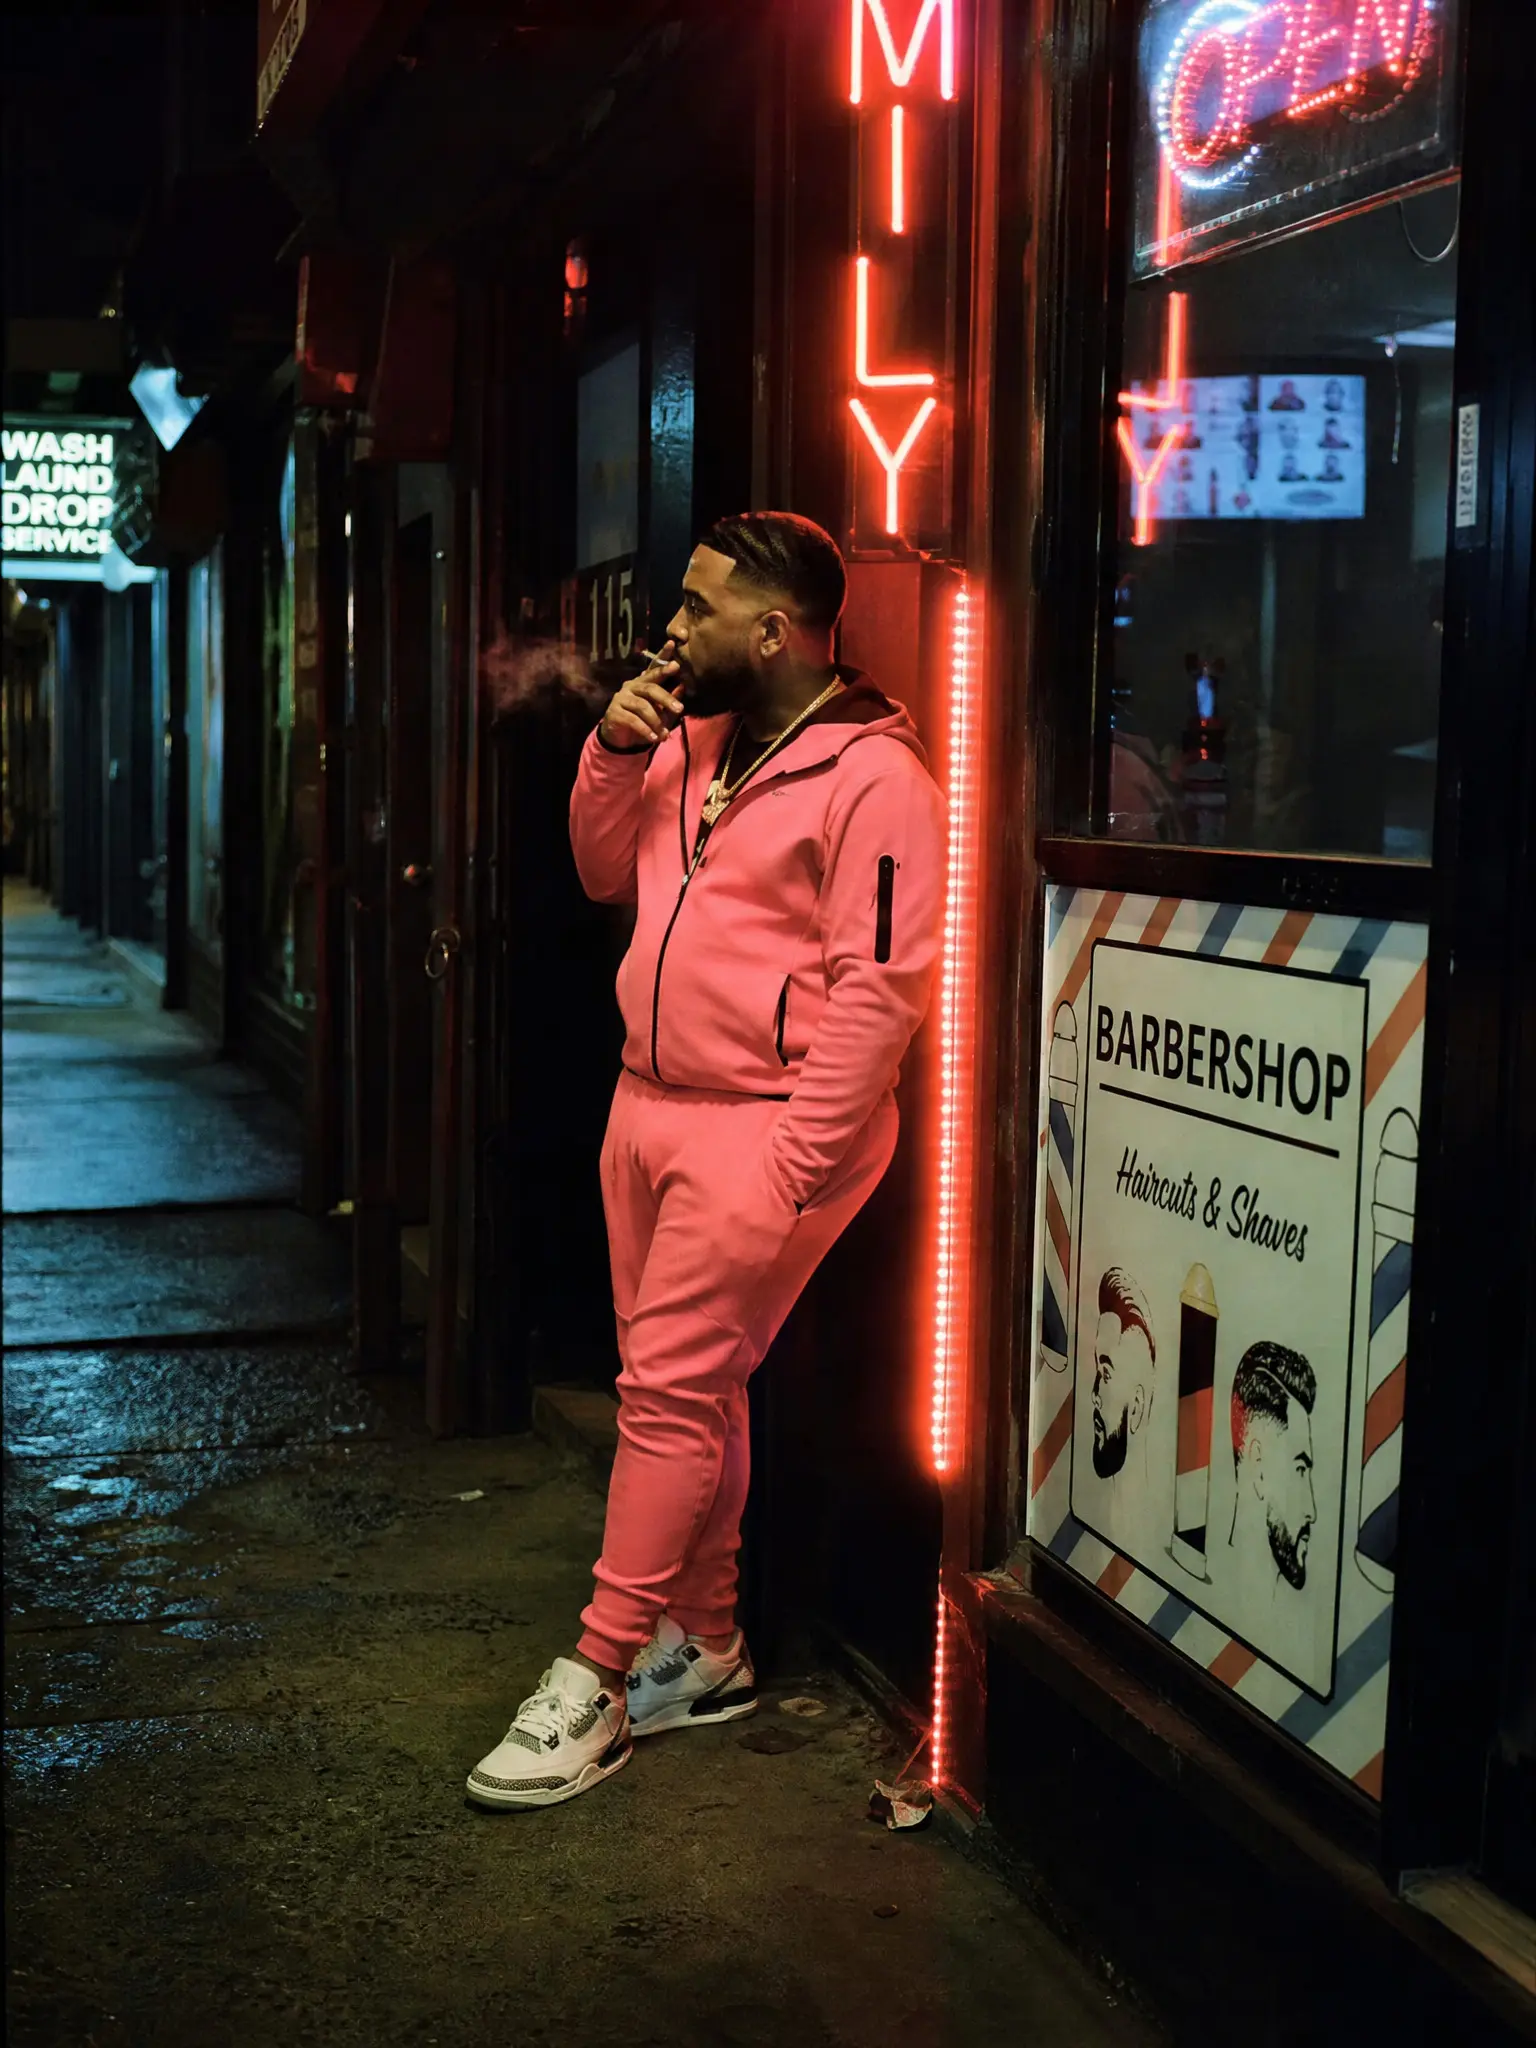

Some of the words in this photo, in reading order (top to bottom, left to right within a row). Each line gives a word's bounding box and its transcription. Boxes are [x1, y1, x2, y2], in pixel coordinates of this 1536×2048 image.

[1, 430, 113, 464] WASH
[2, 492, 114, 527] DROP
[589, 567, 634, 664] 115
[1096, 1004, 1351, 1121] BARBERSHOP
[1116, 1146, 1198, 1221] Haircuts
[1203, 1176, 1222, 1230] &
[1226, 1184, 1308, 1262] Shaves
